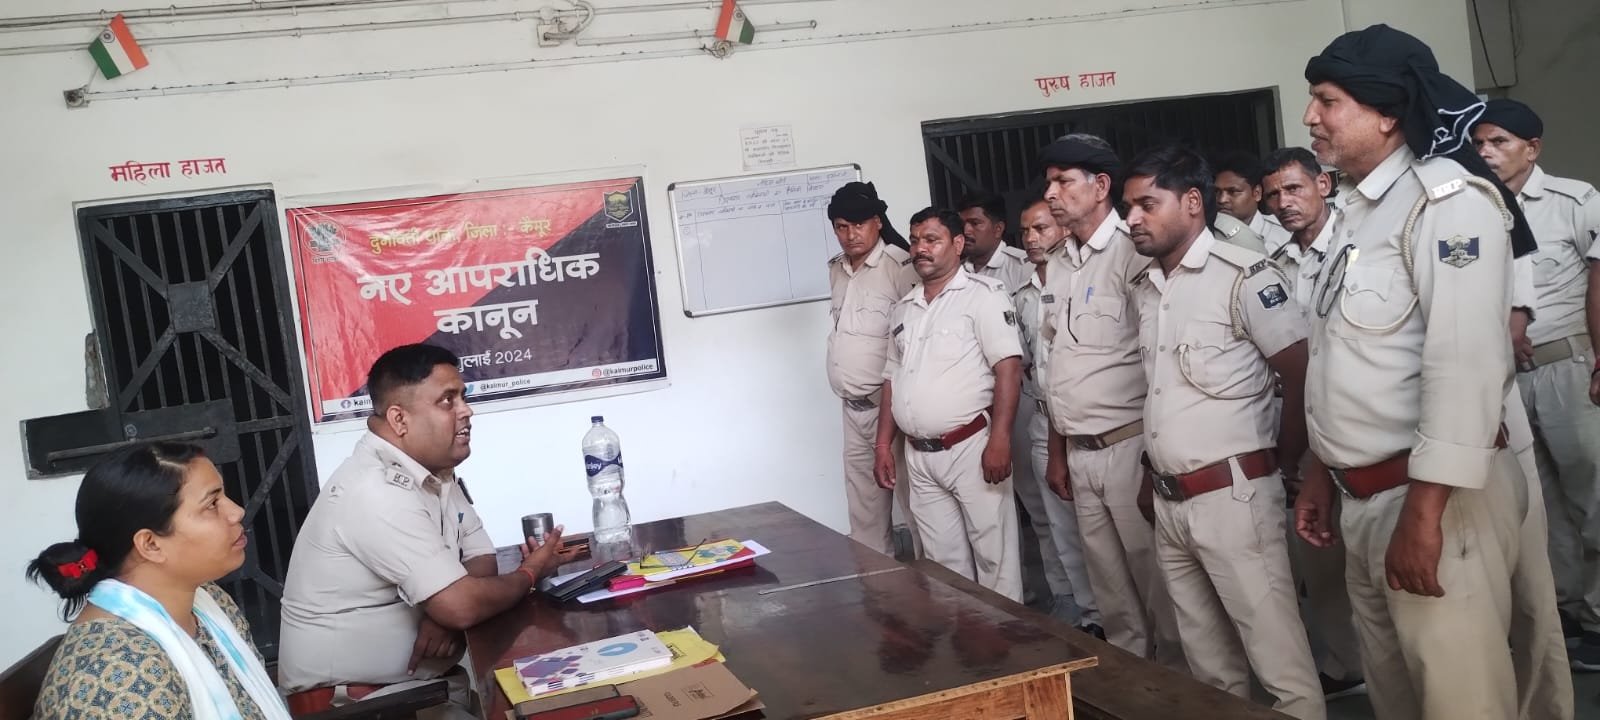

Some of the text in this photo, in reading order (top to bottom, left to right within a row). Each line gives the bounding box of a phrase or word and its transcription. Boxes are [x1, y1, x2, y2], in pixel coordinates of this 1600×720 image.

[1078, 72, 1116, 88] हाजत
[108, 158, 226, 184] महिला हाजत
[463, 221, 497, 240] जिला
[519, 216, 552, 237] कैमूर
[357, 247, 600, 305] नए आपराधिक
[433, 299, 538, 340] कानून
[494, 348, 533, 364] 2024
[480, 379, 531, 392] @kaimur_police
